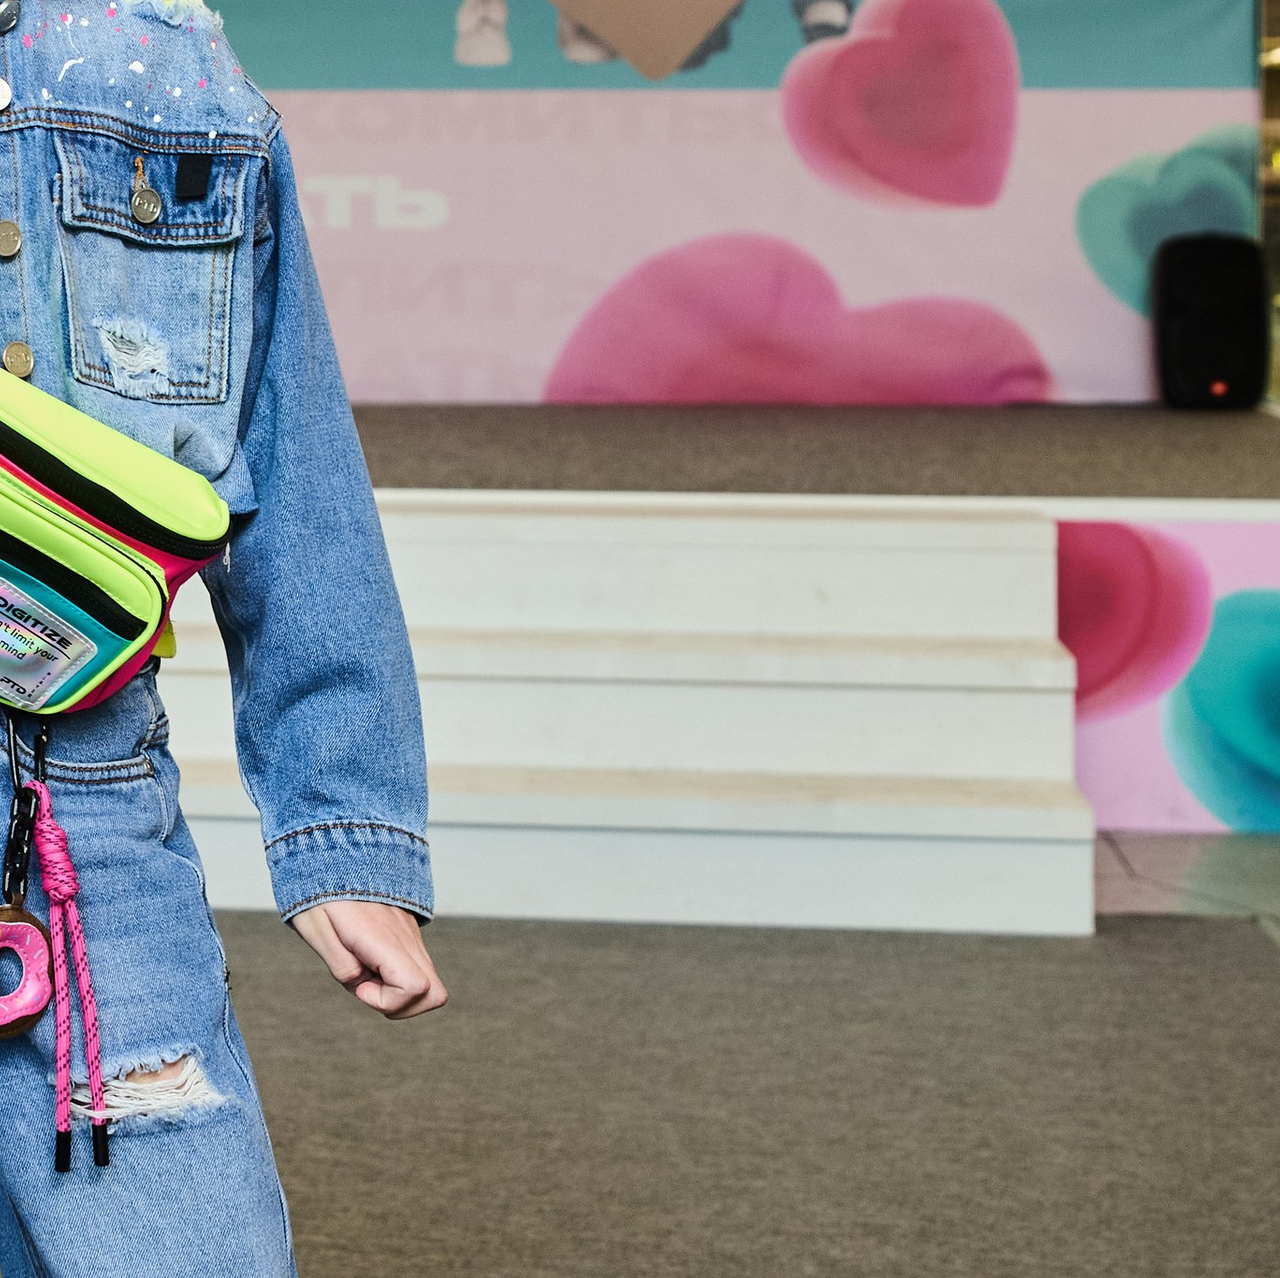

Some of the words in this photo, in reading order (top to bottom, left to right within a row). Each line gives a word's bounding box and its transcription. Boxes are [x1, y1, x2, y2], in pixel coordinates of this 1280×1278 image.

[301, 175, 449, 230] ТЬ
[10, 628, 36, 650] limit
[33, 646, 59, 662] your
[0, 676, 27, 695] PTD
